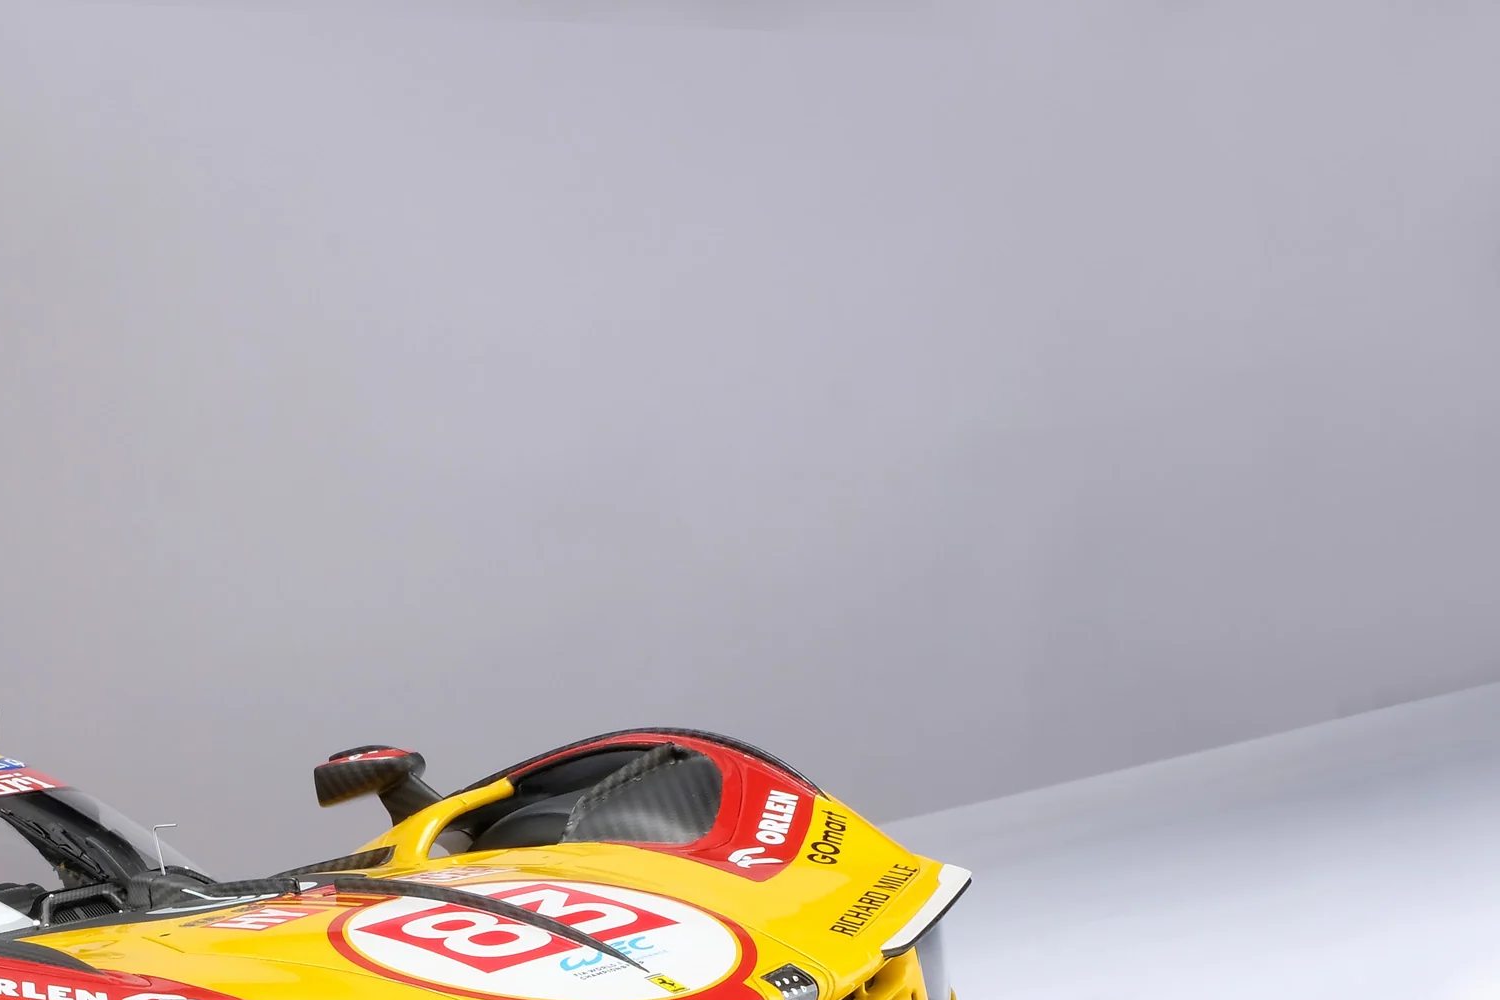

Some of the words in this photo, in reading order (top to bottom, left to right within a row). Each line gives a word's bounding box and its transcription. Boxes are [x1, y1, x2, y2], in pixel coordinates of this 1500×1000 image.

[755, 789, 799, 845] ORLEN
[806, 809, 847, 865] GOmart
[401, 889, 638, 958] 83
[829, 890, 890, 937] RICHARD
[873, 863, 918, 893] MILLE
